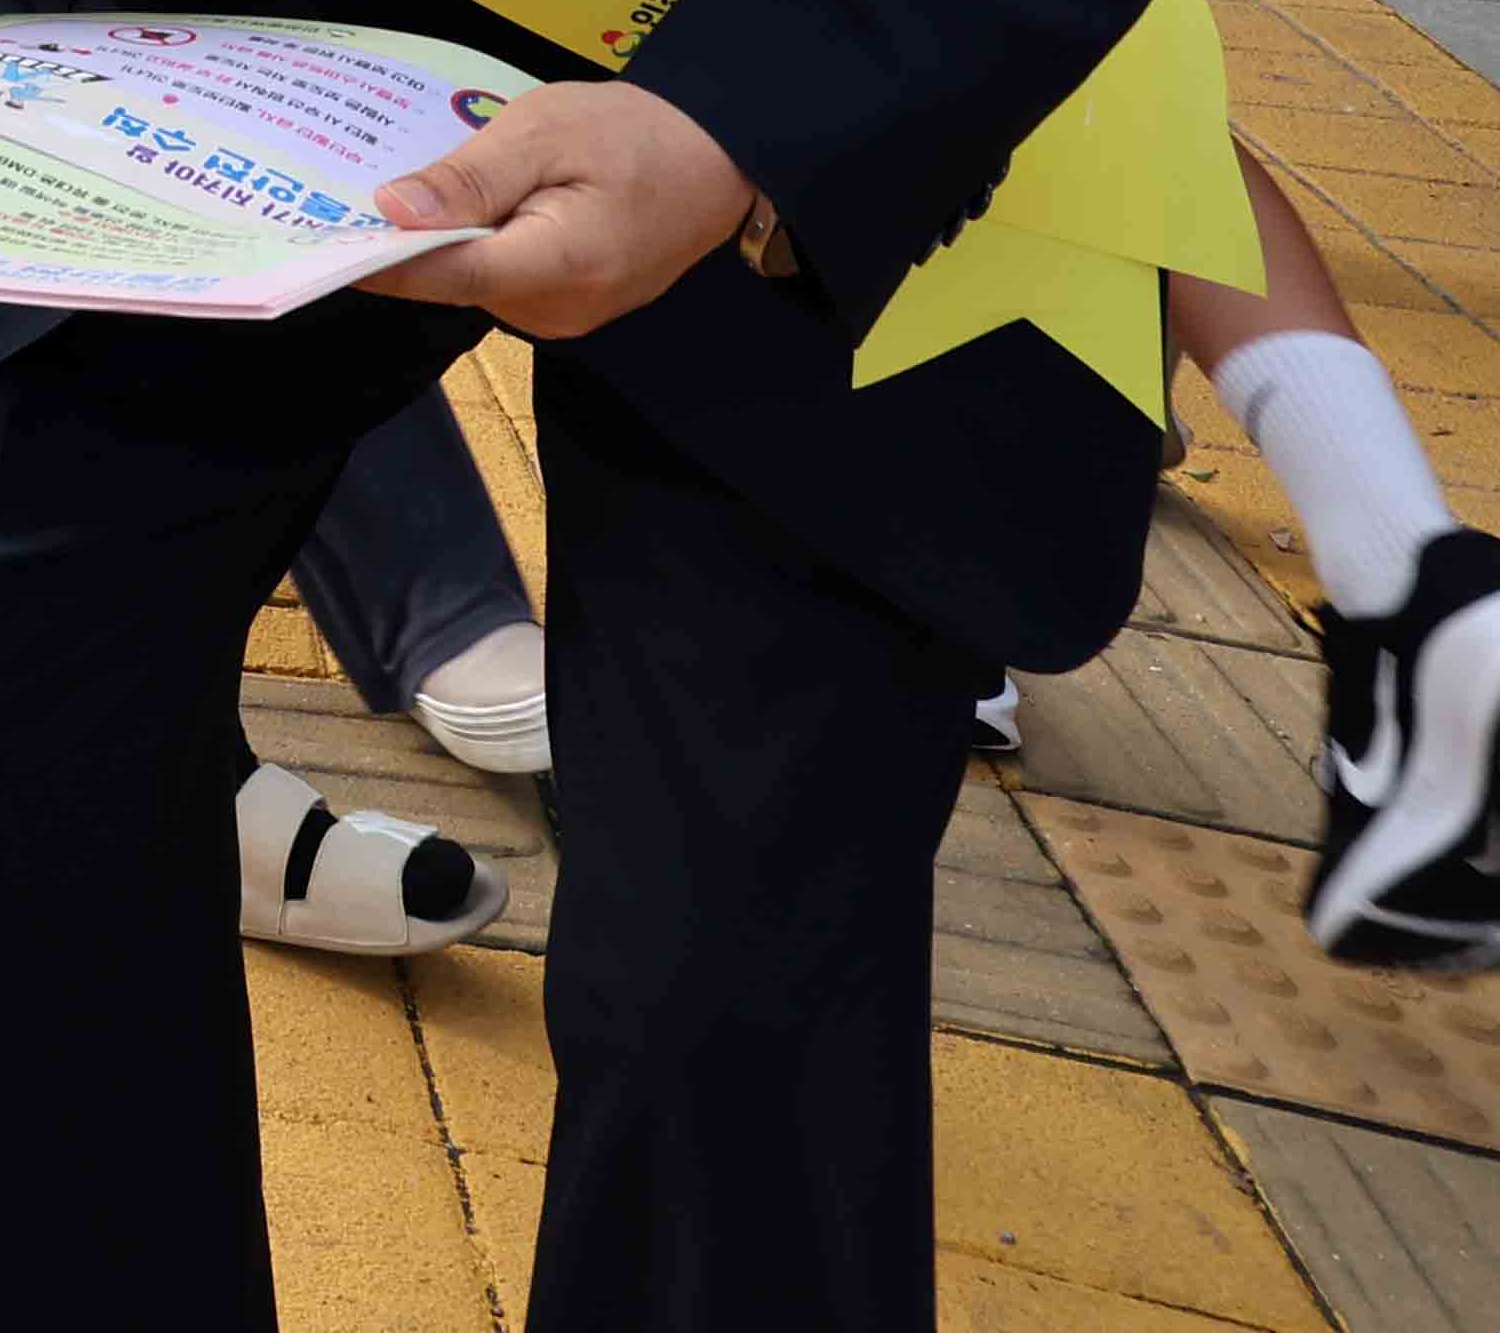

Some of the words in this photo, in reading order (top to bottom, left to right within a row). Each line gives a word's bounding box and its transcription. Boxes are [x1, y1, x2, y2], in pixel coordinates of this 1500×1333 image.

[101, 105, 197, 154] 수칙
[124, 143, 161, 167] 할
[163, 160, 254, 210] 지켜야
